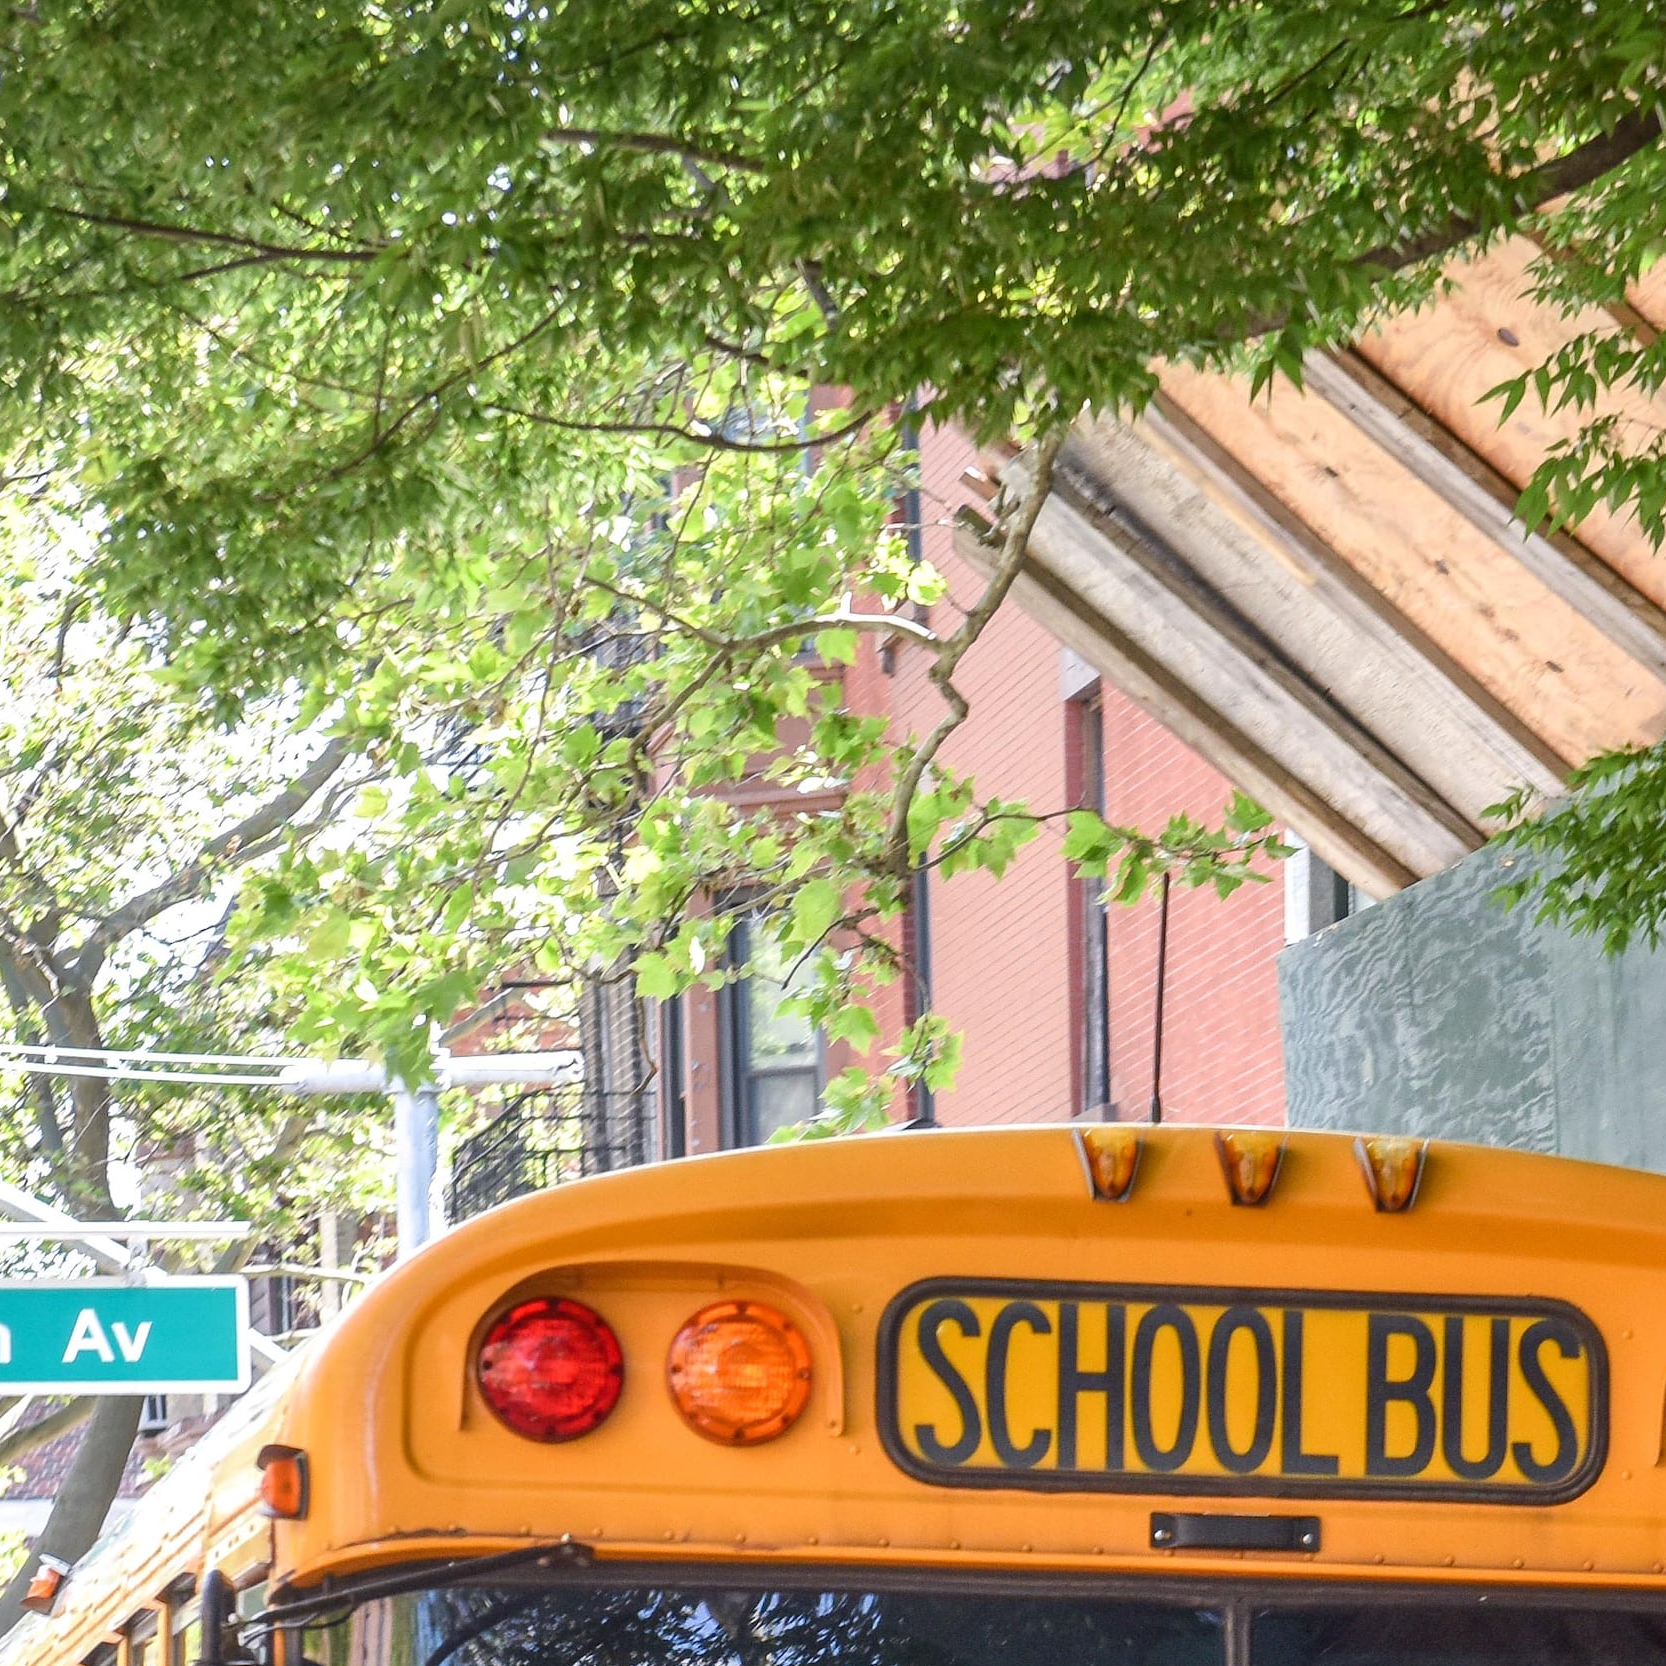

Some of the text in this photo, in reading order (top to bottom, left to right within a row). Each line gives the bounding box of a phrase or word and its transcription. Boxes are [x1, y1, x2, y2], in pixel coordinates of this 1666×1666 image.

[61, 1307, 153, 1363] Av
[914, 1298, 1582, 1484] SCHOOL BUS
